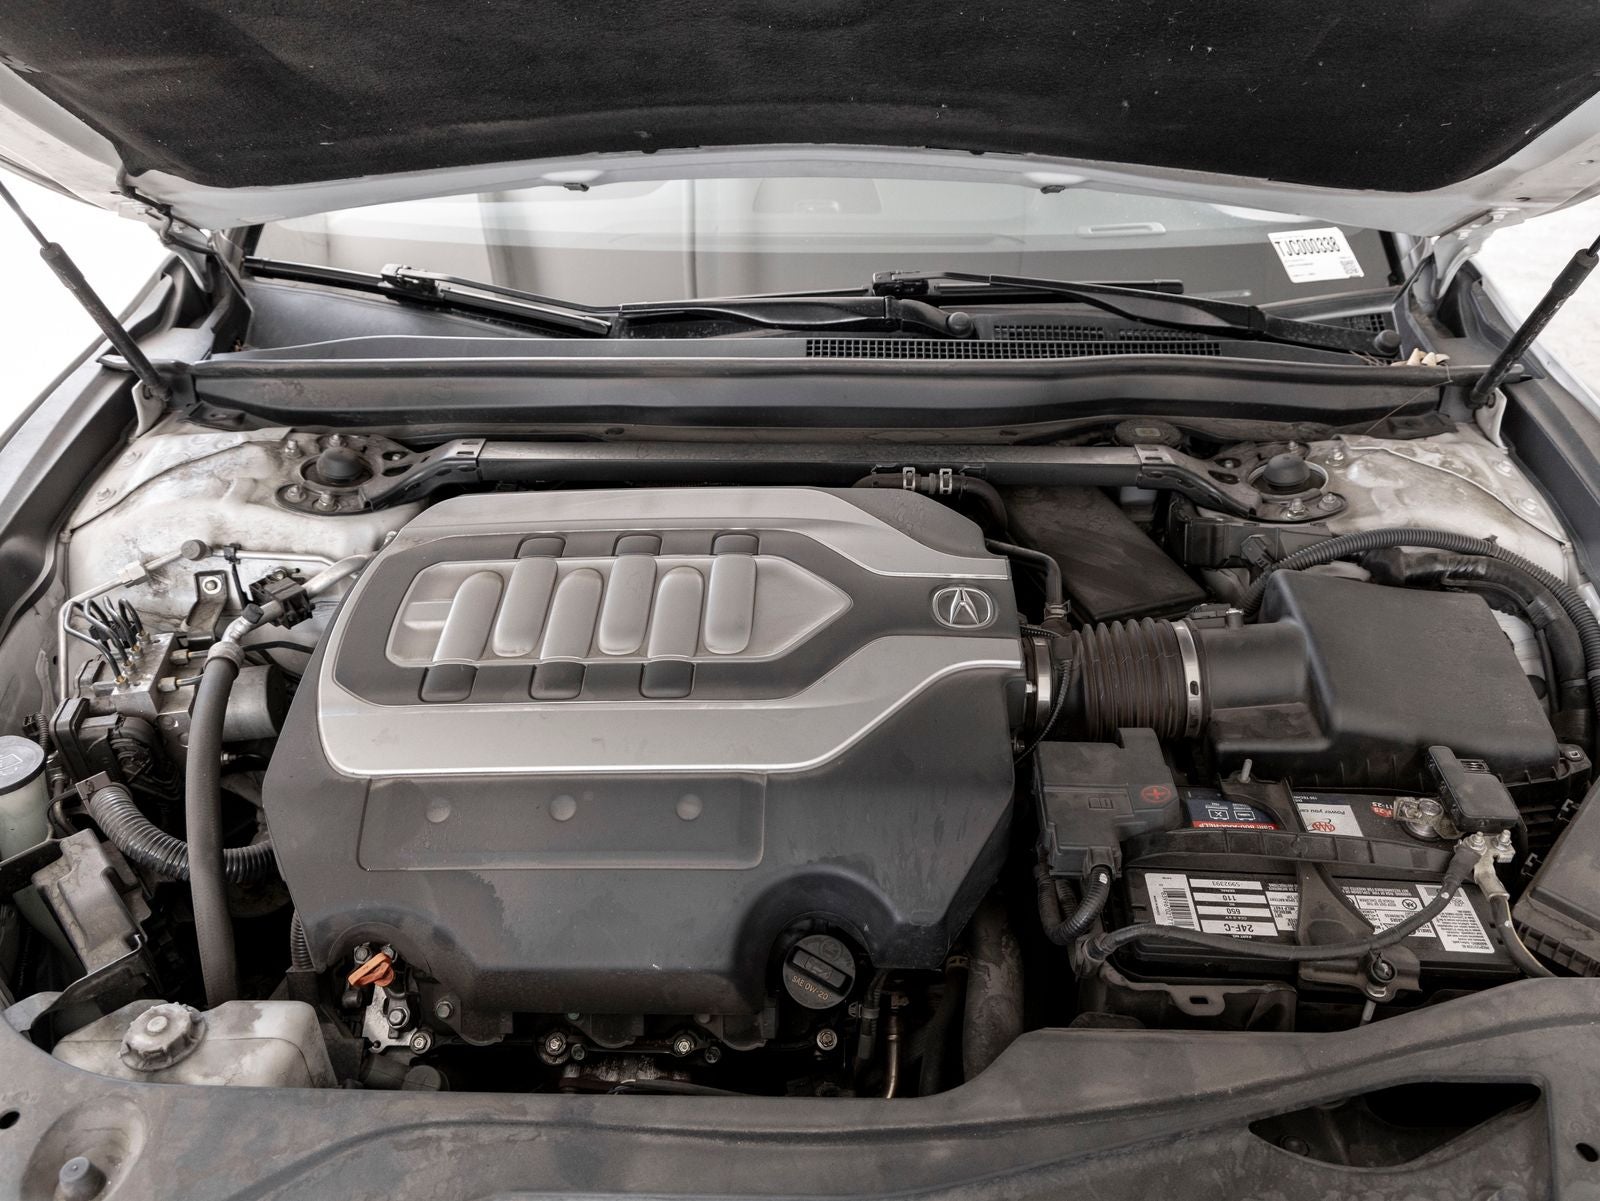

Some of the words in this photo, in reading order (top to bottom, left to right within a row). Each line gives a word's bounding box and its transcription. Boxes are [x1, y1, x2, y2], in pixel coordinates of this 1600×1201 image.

[1274, 236, 1341, 256] TJC000338
[1226, 907, 1241, 915] 650
[1223, 923, 1254, 933] 24F-C
[791, 975, 805, 988] SAE
[804, 982, 828, 1000] 0W-20
